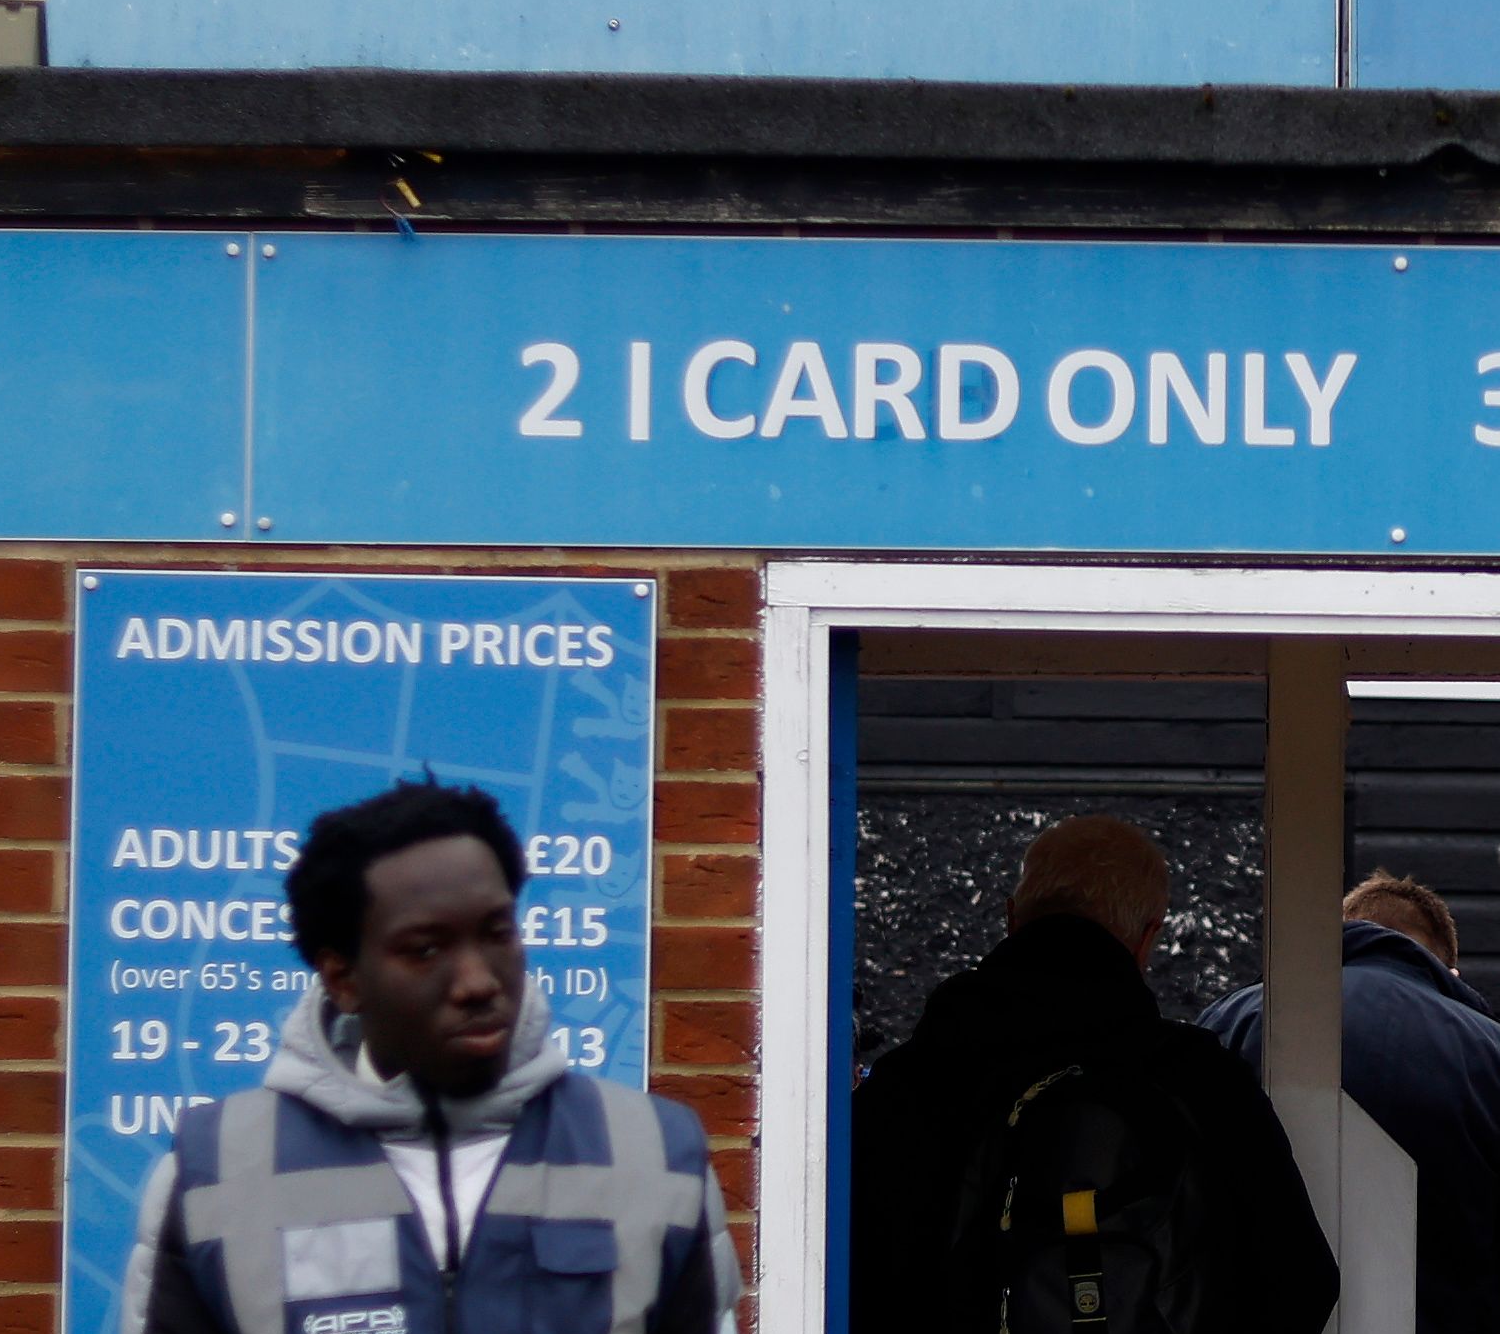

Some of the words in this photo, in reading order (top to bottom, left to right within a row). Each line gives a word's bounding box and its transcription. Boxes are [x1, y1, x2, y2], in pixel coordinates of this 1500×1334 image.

[518, 342, 583, 438] 2
[684, 340, 1020, 442] CARD
[1047, 349, 1358, 447] ONLY
[117, 617, 424, 664] ADMISSION
[438, 623, 615, 668] PRICES
[113, 829, 300, 870] ADULTS
[525, 834, 612, 875] £20
[110, 899, 296, 942] CONCES
[521, 906, 608, 947] £15
[110, 960, 187, 996] (over
[200, 964, 262, 991] 65's
[565, 968, 609, 1002] ID)
[111, 1019, 168, 1061] 19
[213, 1022, 272, 1063] 23
